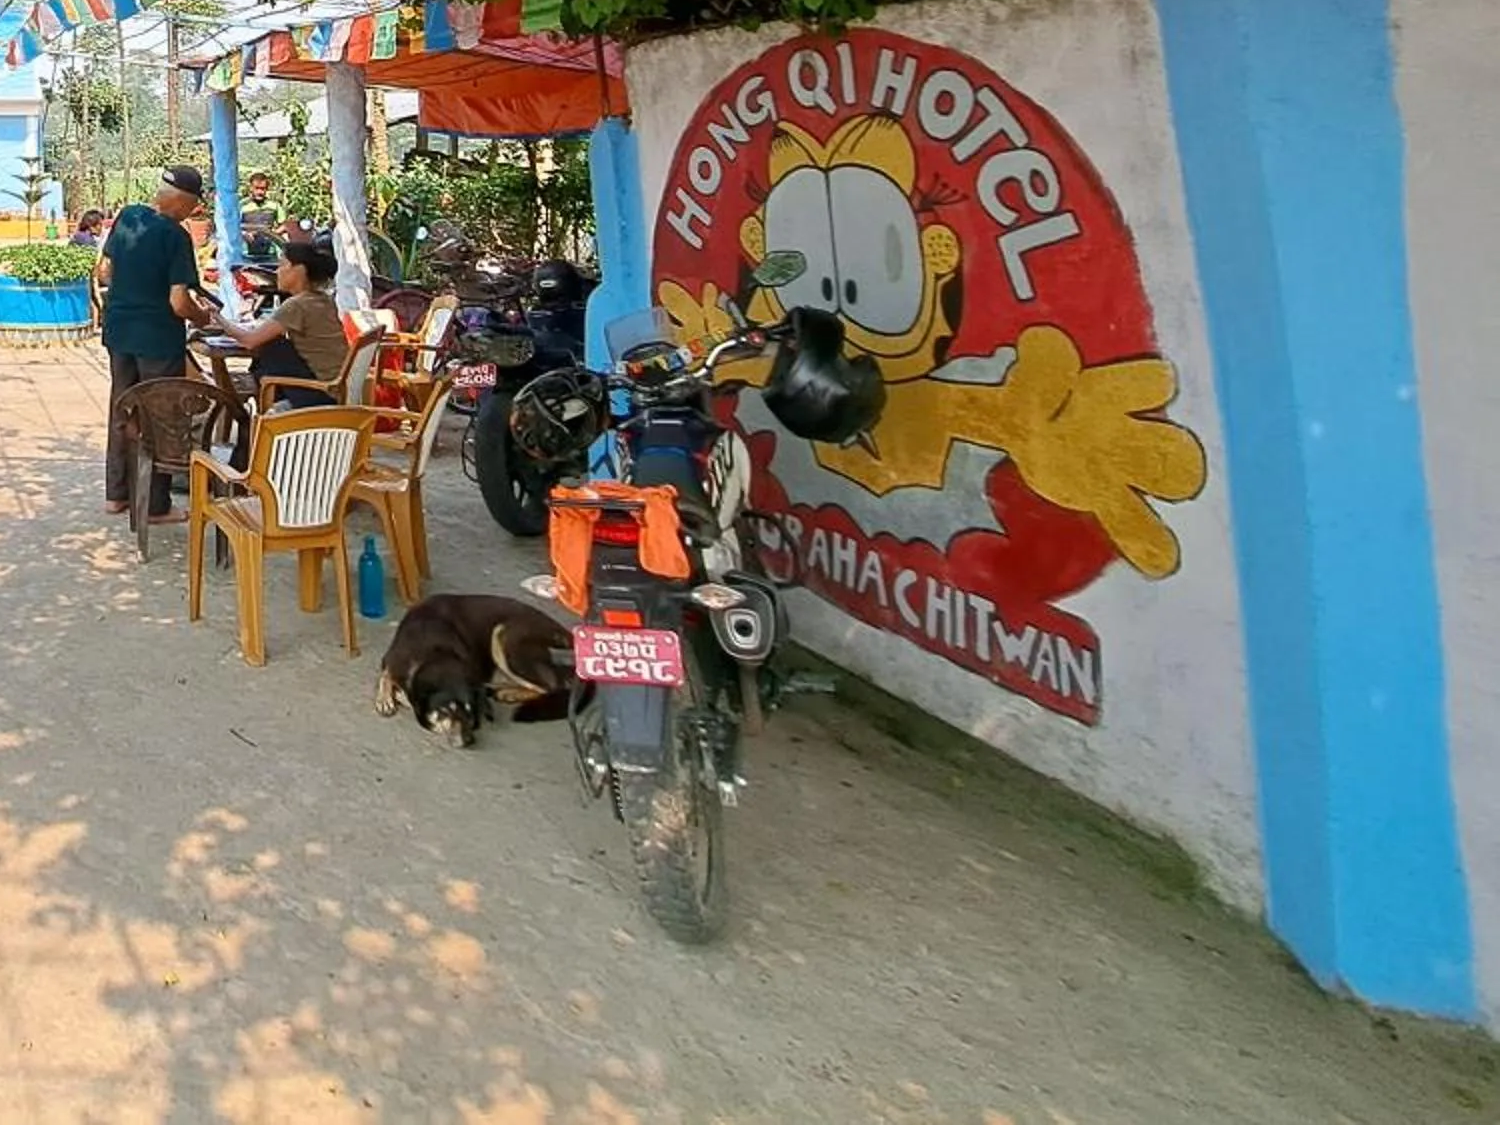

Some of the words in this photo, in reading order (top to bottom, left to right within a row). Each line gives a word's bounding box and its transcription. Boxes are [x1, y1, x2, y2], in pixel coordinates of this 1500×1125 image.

[665, 75, 777, 250] HONG
[786, 41, 857, 117] QI
[894, 568, 1096, 707] CHITWAN
